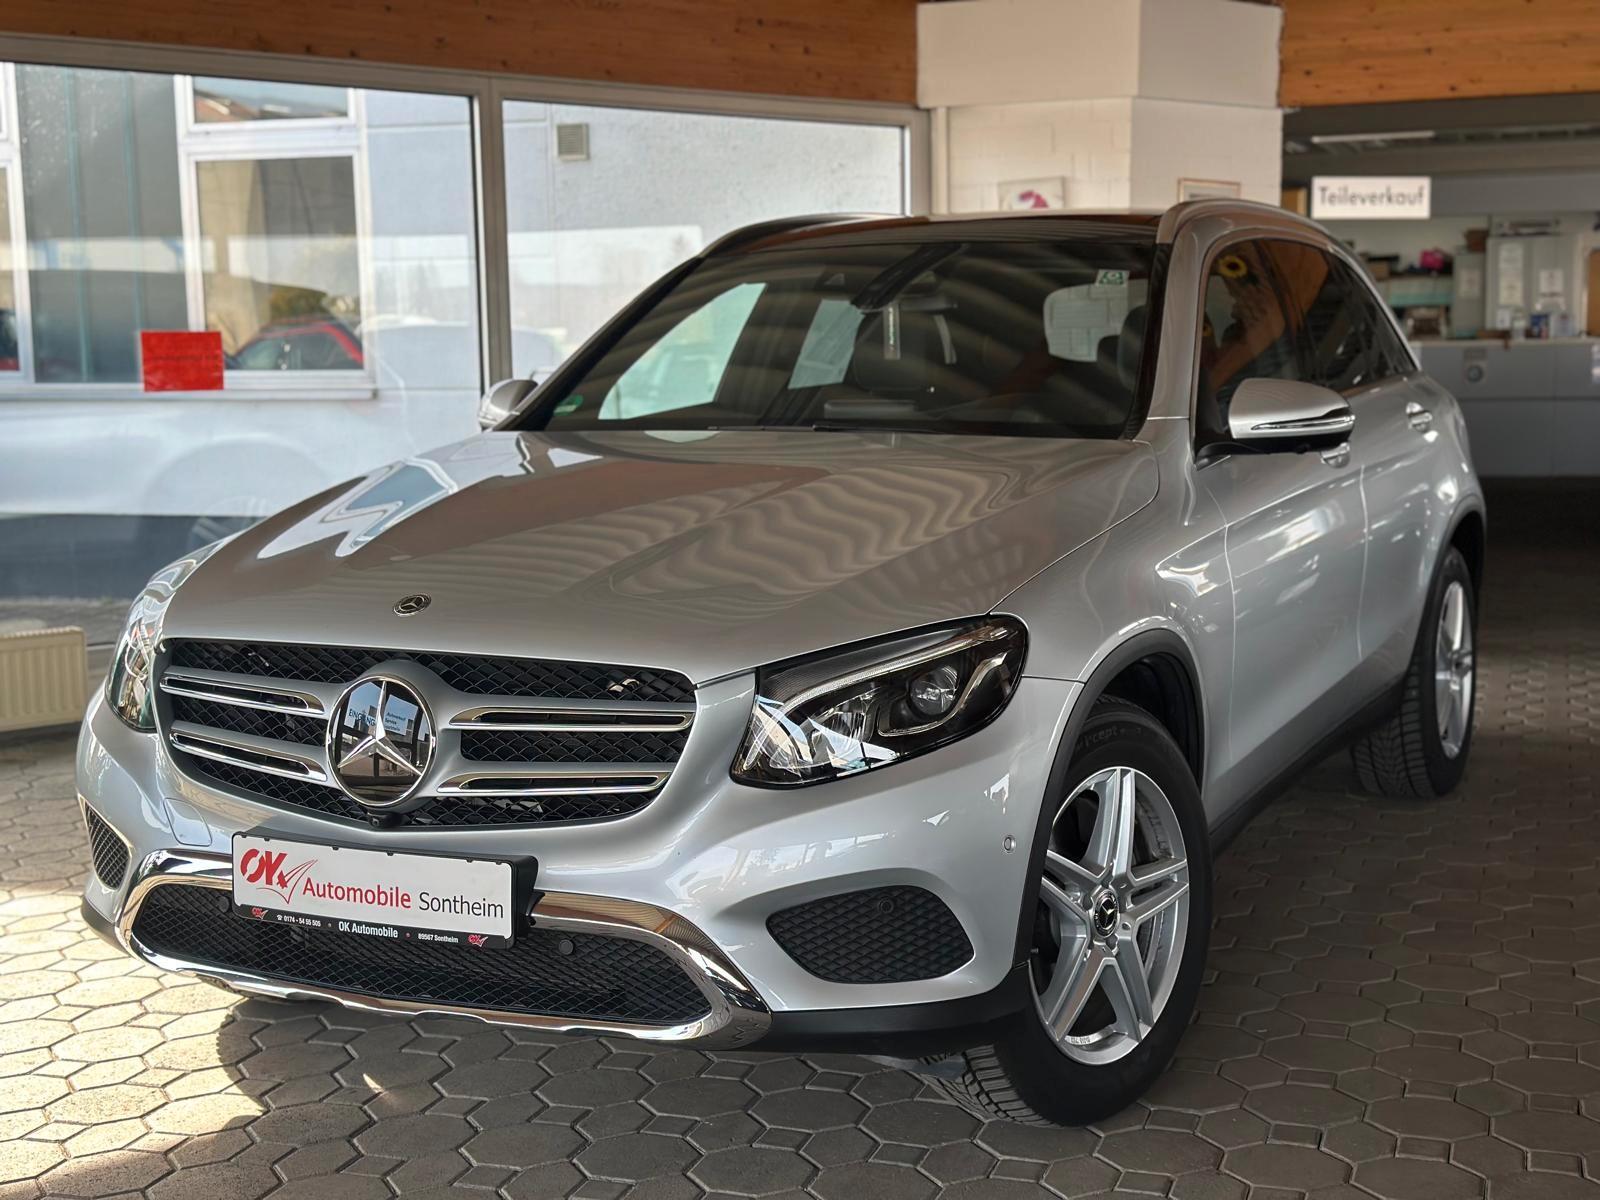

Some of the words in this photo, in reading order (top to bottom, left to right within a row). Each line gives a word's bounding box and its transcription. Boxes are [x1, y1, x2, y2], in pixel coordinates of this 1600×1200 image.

[1319, 185, 1425, 205] Teileverkauf
[302, 877, 412, 909] Automobile
[418, 892, 504, 919] Sontheim
[283, 915, 295, 923] 0174
[298, 917, 305, 925] 54
[339, 921, 350, 932] OK
[351, 922, 399, 938] Automobile
[434, 934, 459, 943] Sontheim
